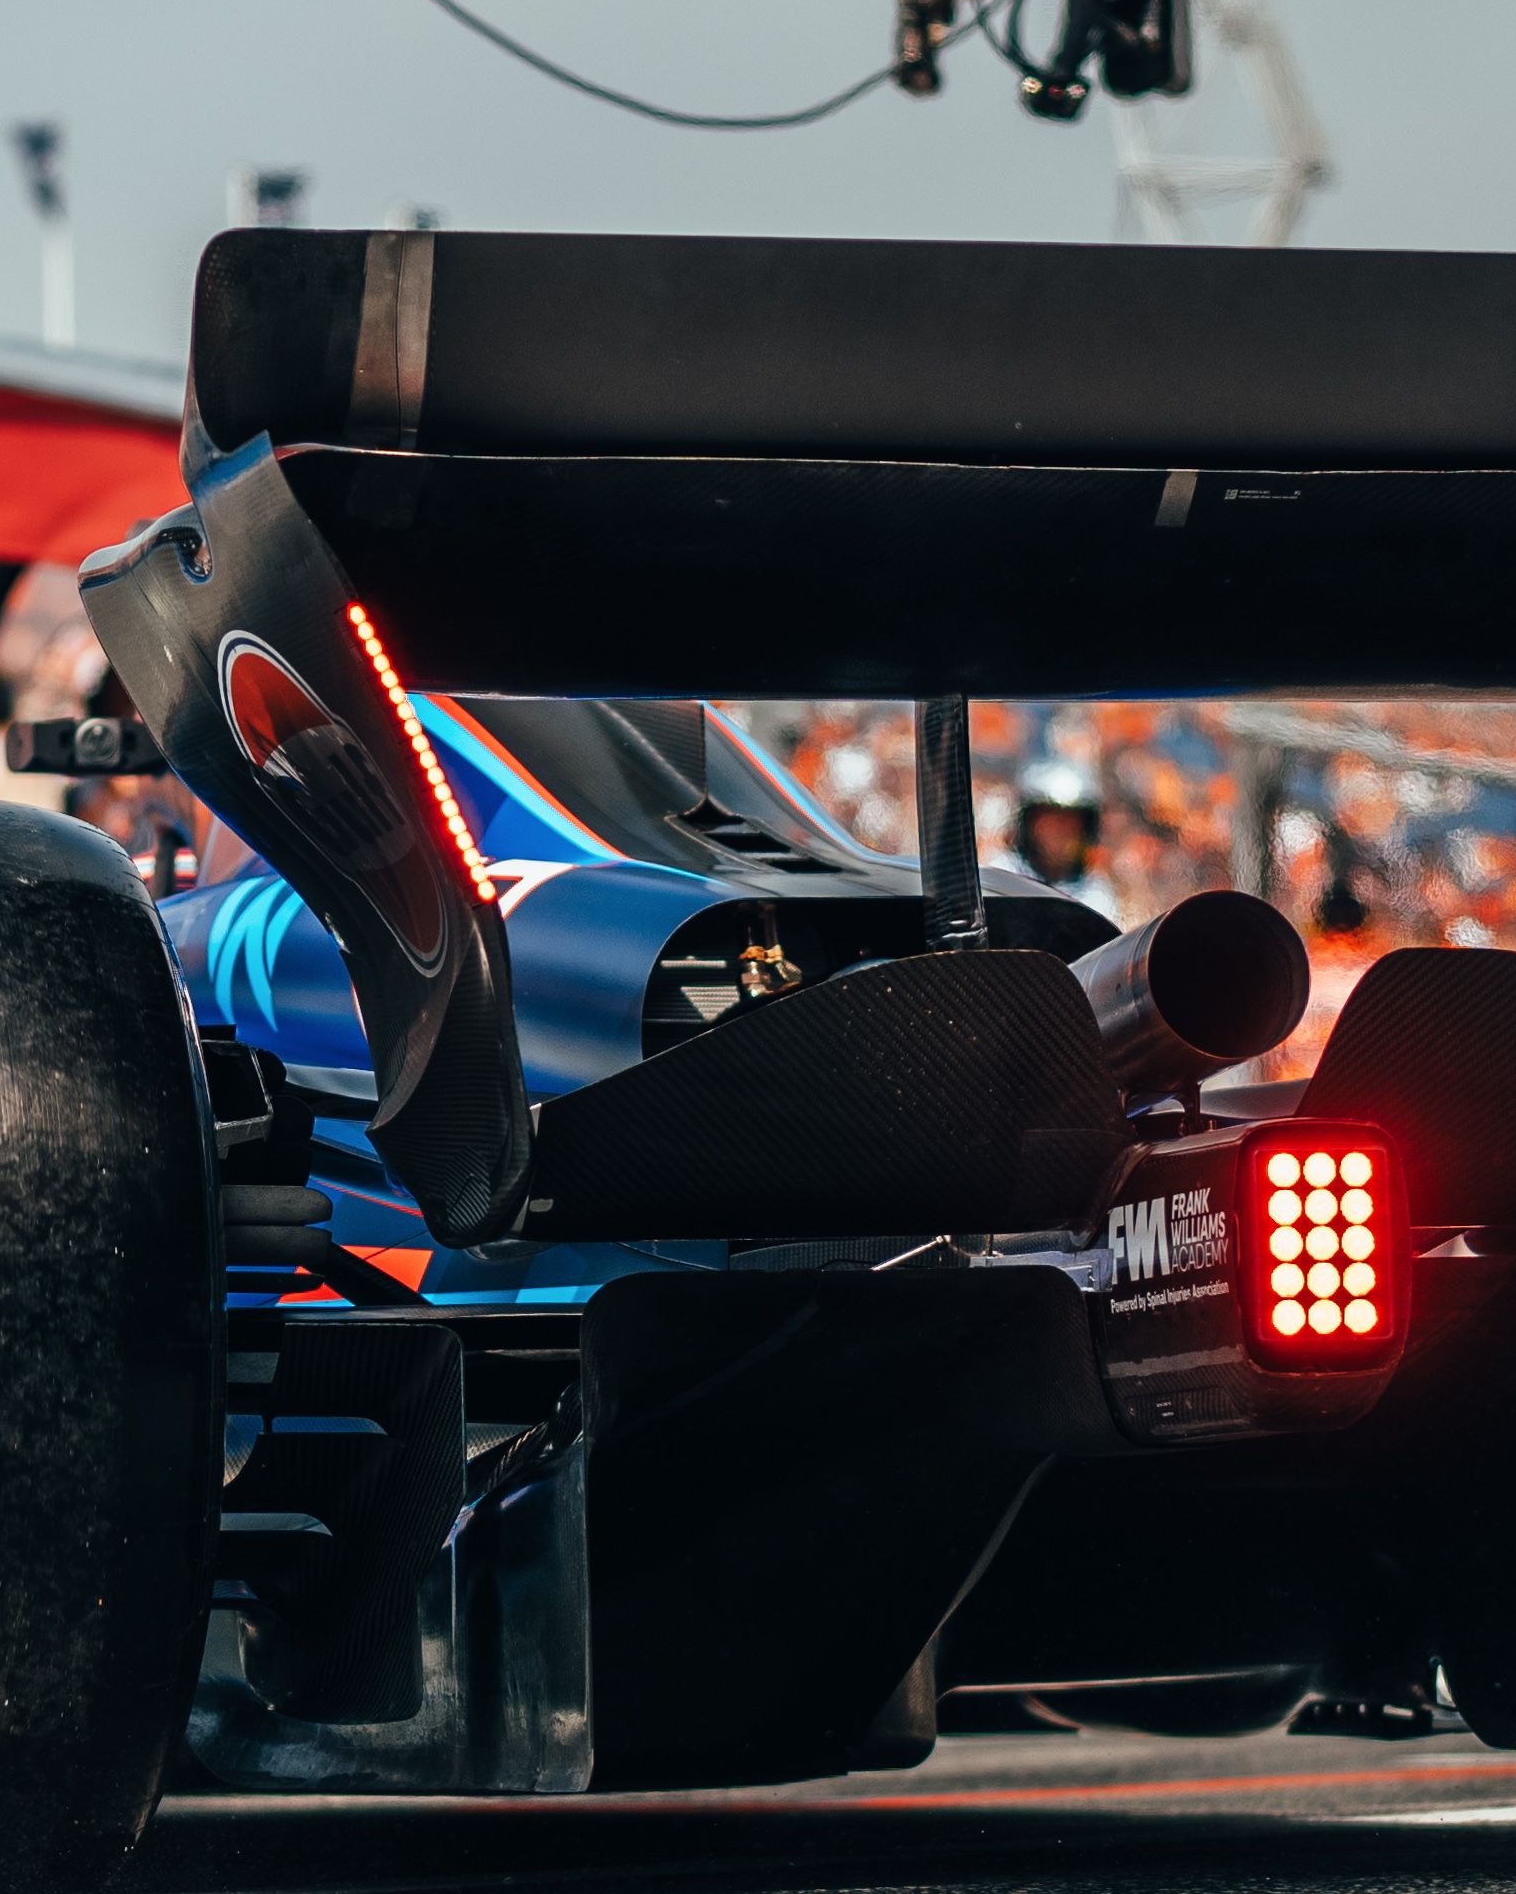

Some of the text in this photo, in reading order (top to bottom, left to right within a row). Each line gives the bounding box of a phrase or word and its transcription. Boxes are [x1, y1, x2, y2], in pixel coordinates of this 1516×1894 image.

[1171, 1187, 1211, 1220] FRANK
[1170, 1211, 1226, 1246] WILLIAMS
[1170, 1238, 1230, 1274] ACADEMY
[1110, 1295, 1138, 1314] Powered
[1138, 1293, 1147, 1312] by
[1147, 1289, 1167, 1312] Spinal
[1167, 1284, 1192, 1305] Injuries
